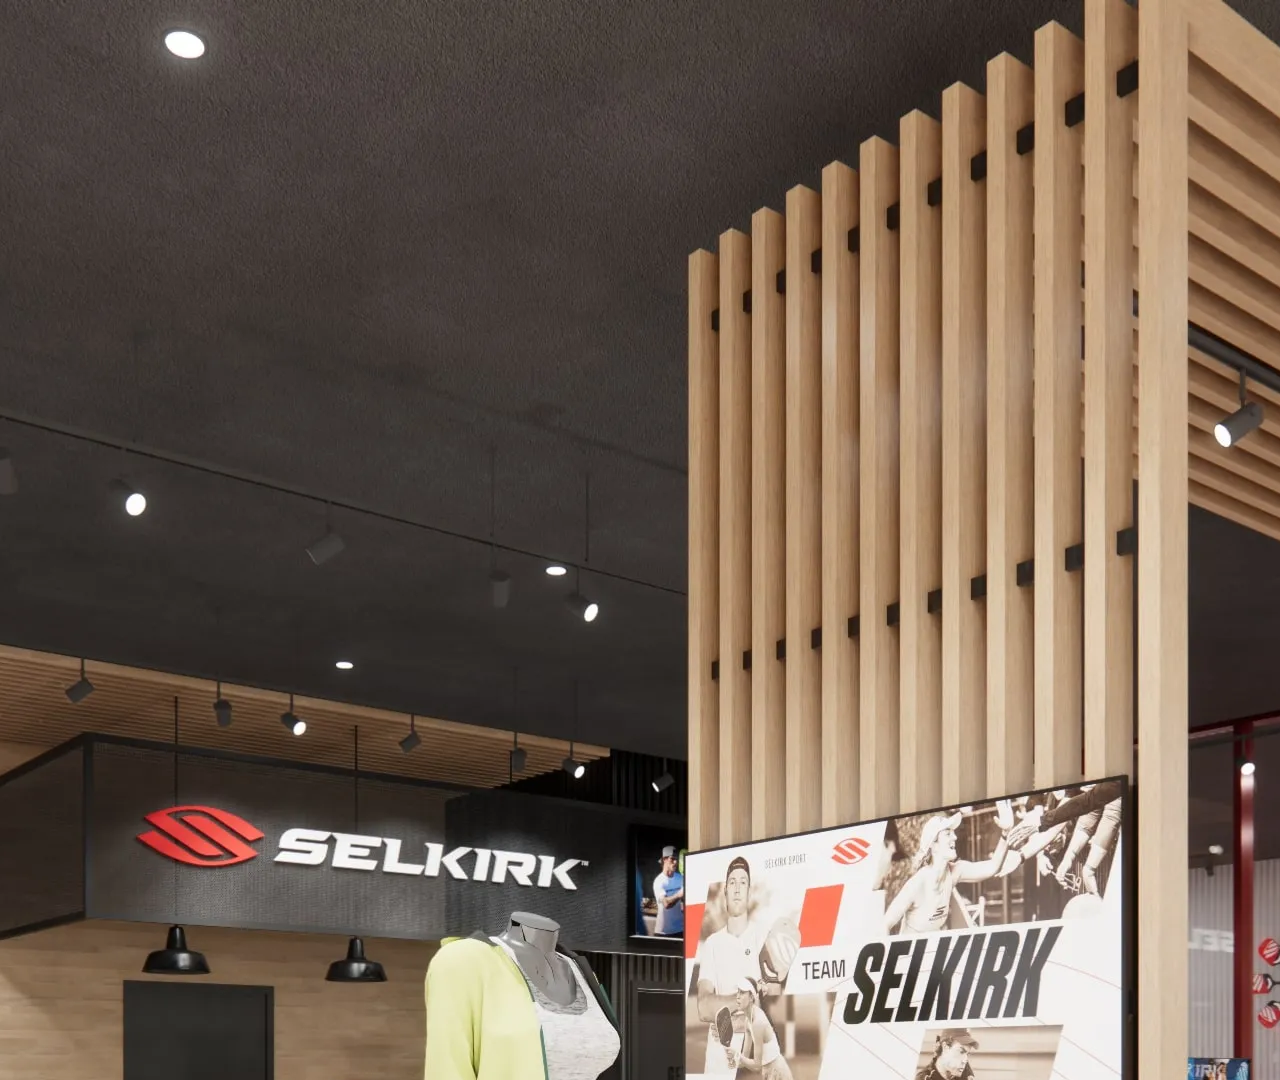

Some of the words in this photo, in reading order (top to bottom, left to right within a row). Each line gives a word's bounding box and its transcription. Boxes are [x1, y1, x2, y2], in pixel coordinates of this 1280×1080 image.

[273, 827, 583, 891] SELKIRK
[802, 959, 846, 980] TEAM
[842, 925, 1064, 1025] SELKIRK
